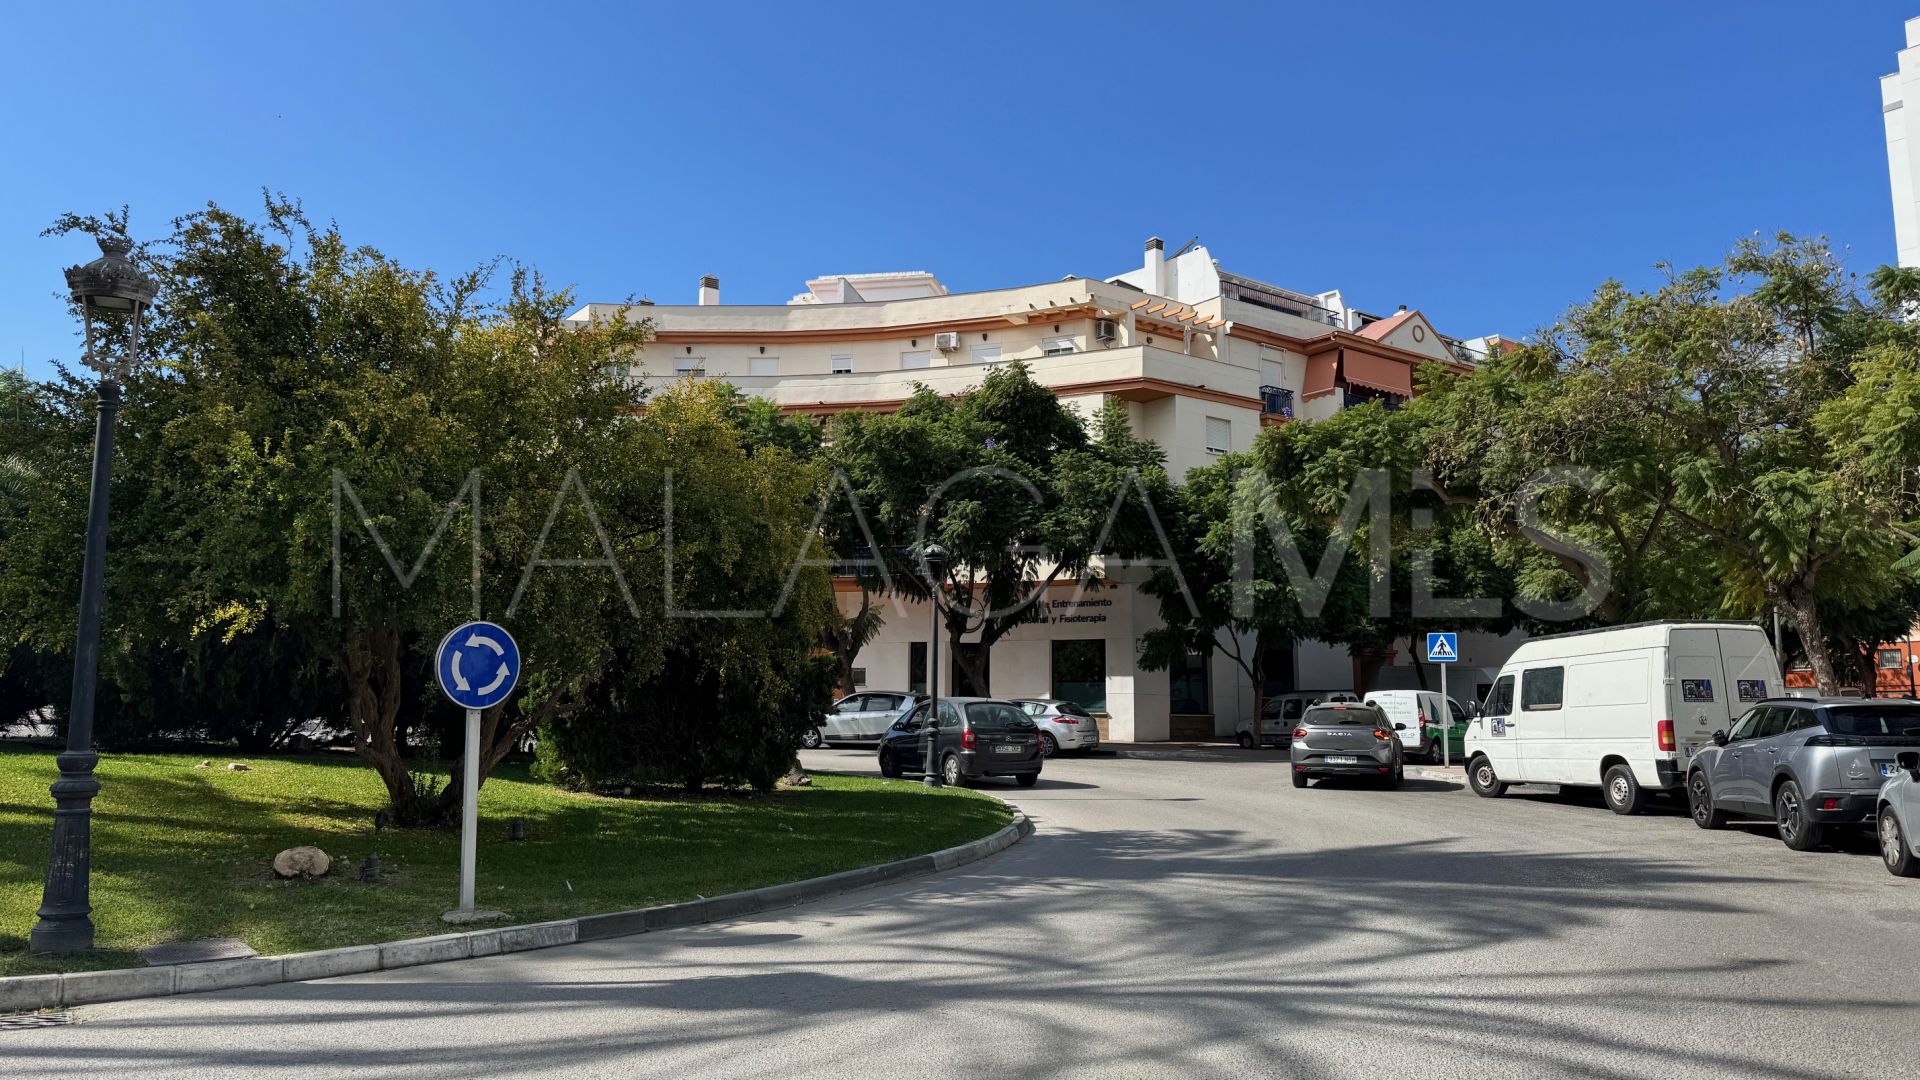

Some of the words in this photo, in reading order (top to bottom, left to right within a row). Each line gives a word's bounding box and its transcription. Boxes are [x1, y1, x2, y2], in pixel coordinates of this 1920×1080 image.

[1052, 598, 1113, 609] Entrenamiento
[1051, 616, 1057, 625] y
[1059, 613, 1106, 624] Fisioterapia
